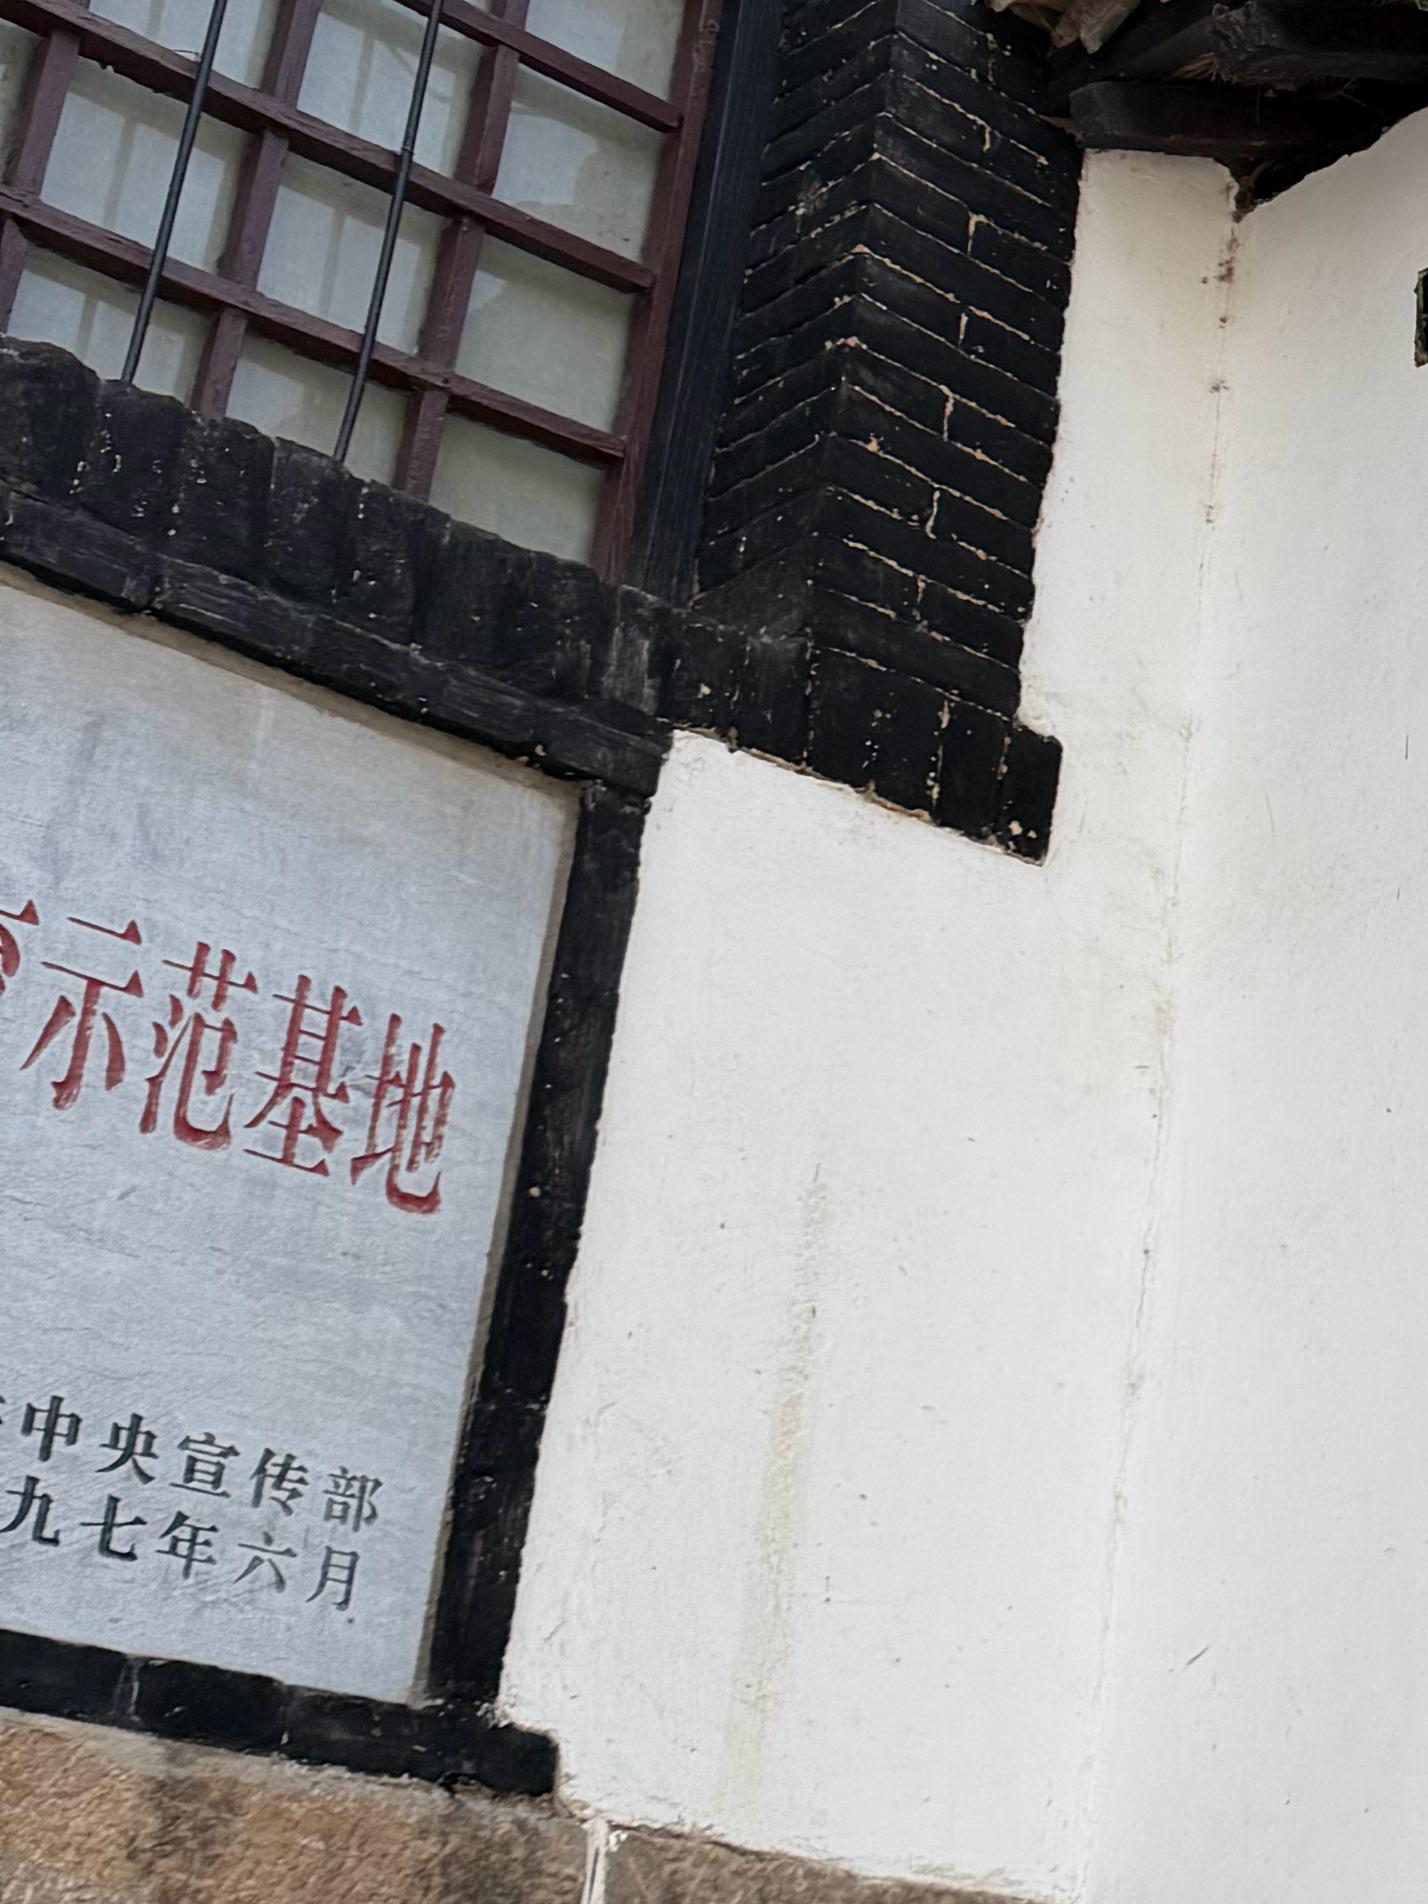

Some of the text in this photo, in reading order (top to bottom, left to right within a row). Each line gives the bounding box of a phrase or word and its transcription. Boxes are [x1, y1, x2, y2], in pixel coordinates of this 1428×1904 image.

[0, 1395, 383, 1533] 中央宣传部
[0, 1475, 361, 1612] 九七年六月
